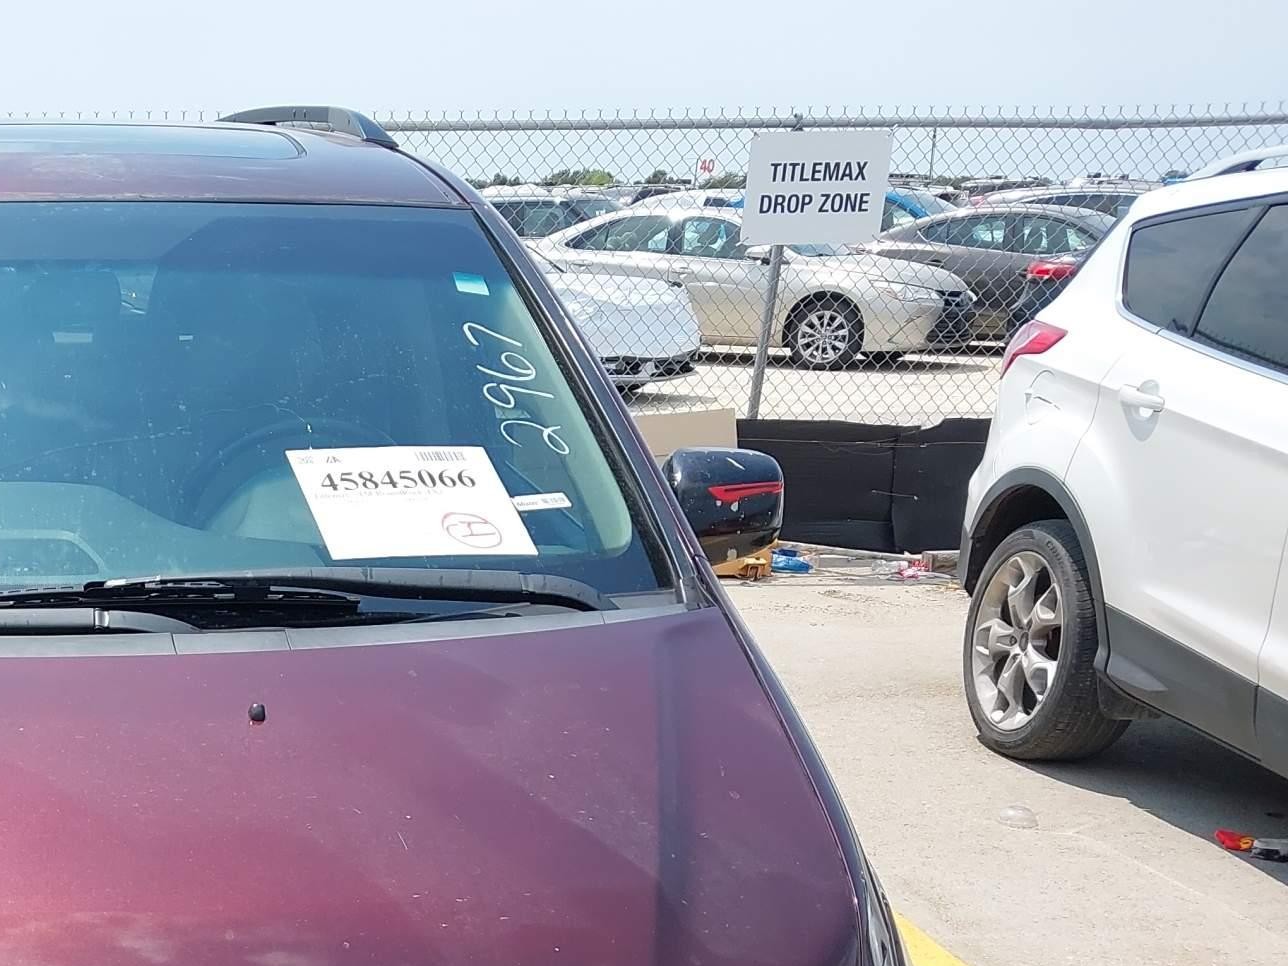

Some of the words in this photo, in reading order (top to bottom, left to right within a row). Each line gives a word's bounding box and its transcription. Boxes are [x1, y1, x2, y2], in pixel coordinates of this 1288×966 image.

[699, 158, 715, 174] 40
[770, 161, 869, 183] TITLEMAX
[759, 194, 812, 214] DROP
[817, 193, 871, 213] ZONE
[462, 322, 570, 455] 2967
[320, 468, 477, 492] 45845066
